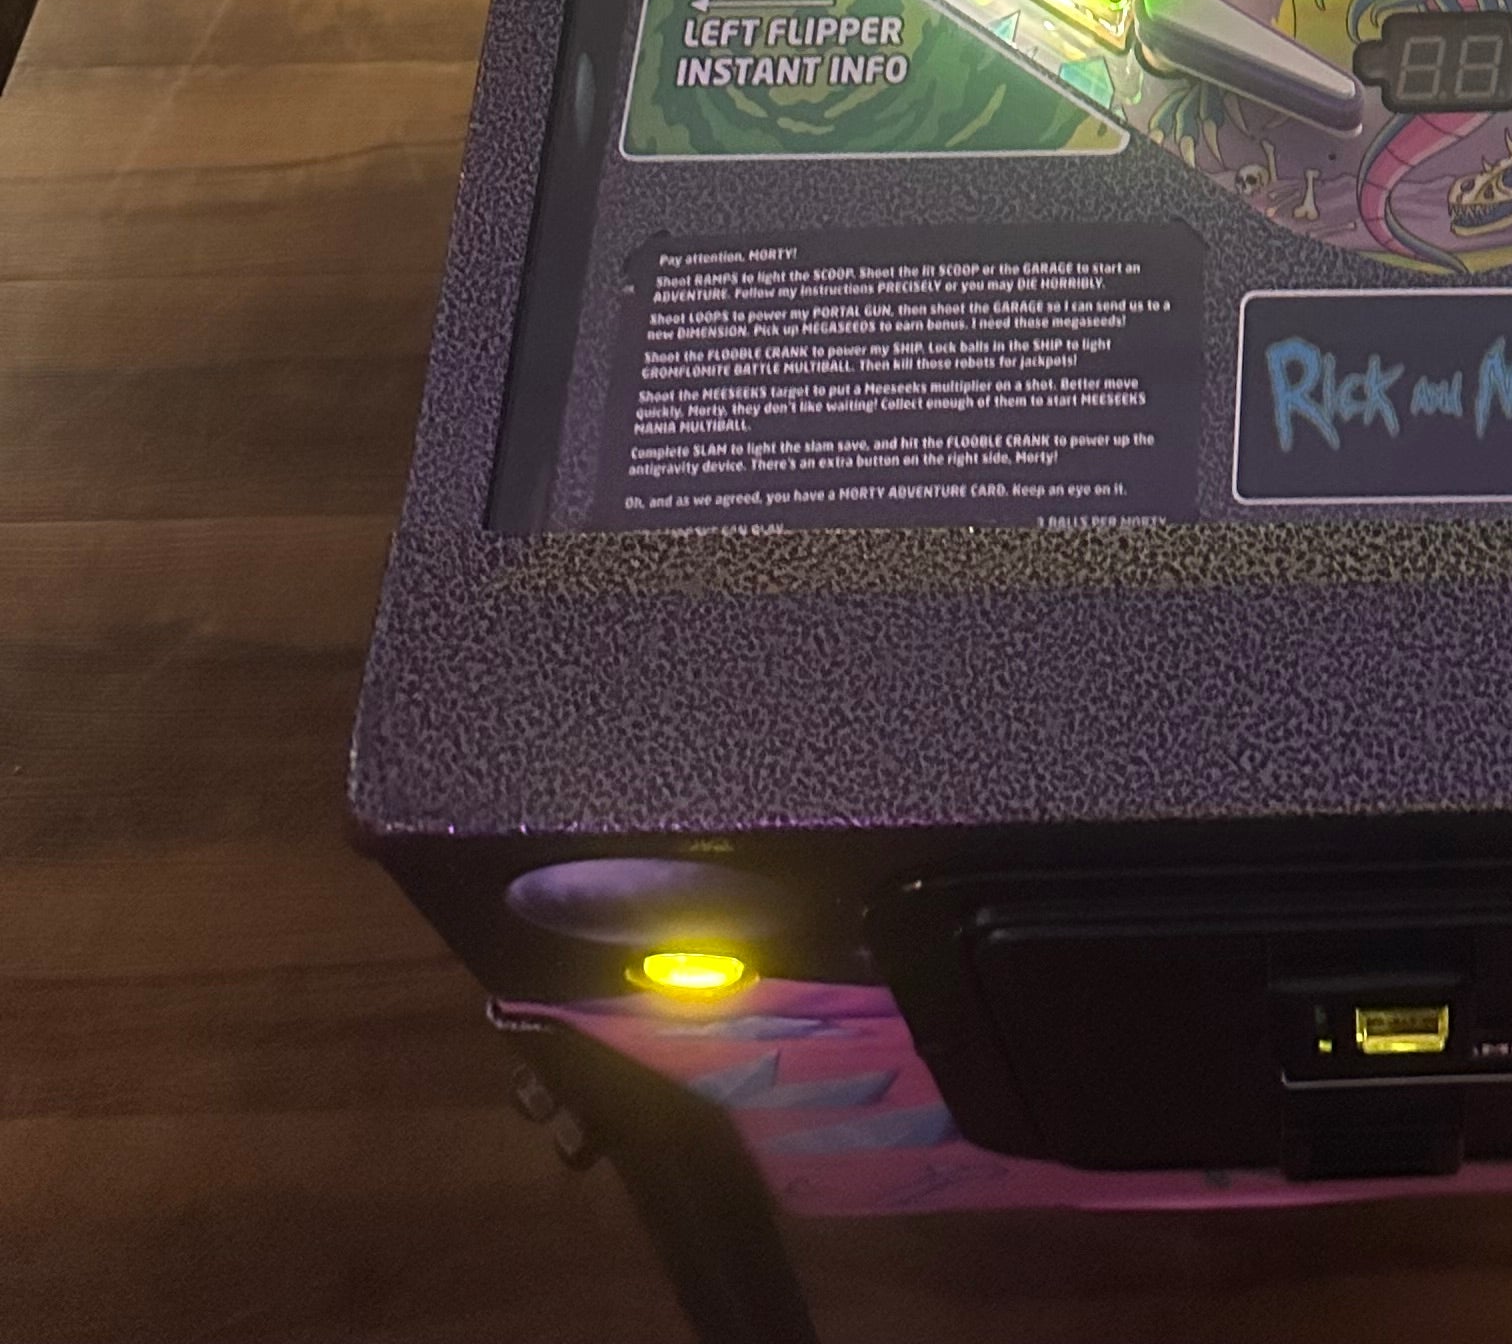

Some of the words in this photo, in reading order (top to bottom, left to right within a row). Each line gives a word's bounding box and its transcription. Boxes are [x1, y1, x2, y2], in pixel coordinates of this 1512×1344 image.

[684, 17, 757, 47] LEFT
[767, 15, 903, 46] FLIPPER
[675, 56, 819, 87] INSTANT
[827, 54, 909, 85] INFO
